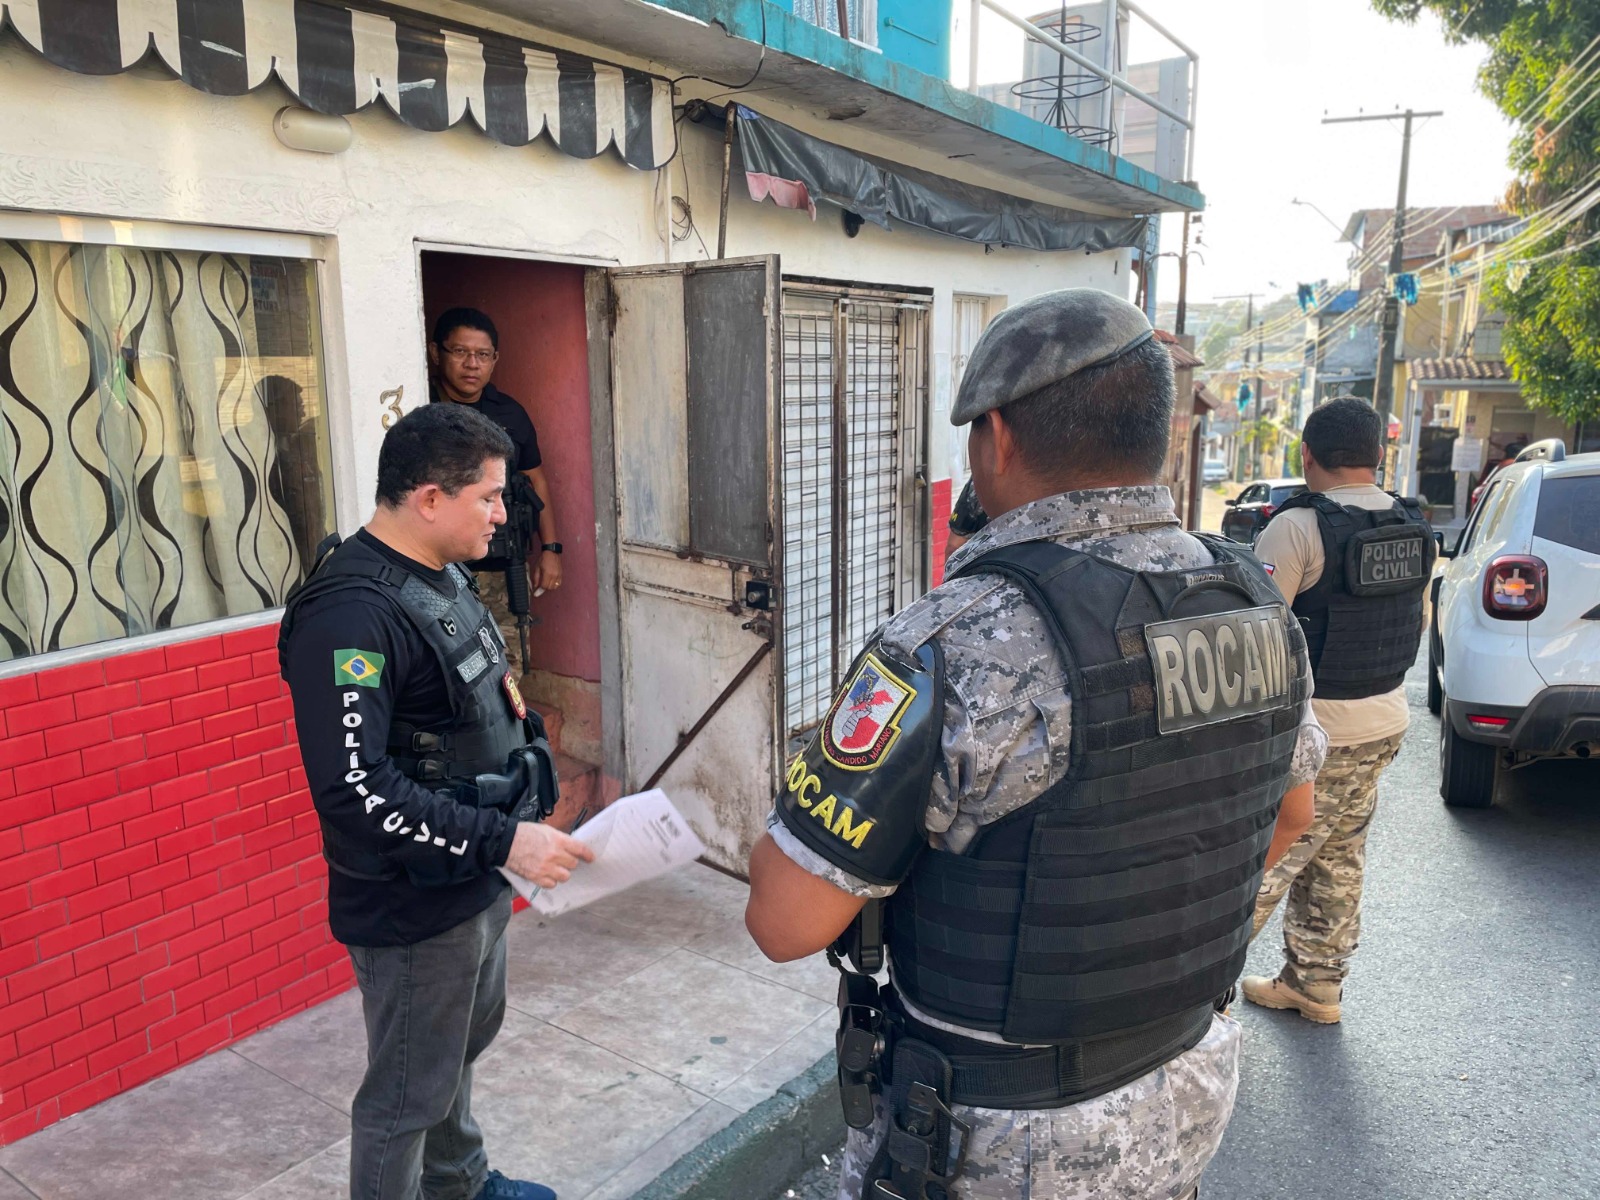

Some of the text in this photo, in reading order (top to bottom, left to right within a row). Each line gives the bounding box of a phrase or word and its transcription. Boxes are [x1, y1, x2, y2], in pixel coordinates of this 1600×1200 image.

[380, 385, 403, 430] 3
[1372, 561, 1412, 580] CIVIL
[1152, 618, 1288, 718] ROCAM
[868, 728, 892, 760] MARIANO
[383, 811, 468, 856] CIVIL
